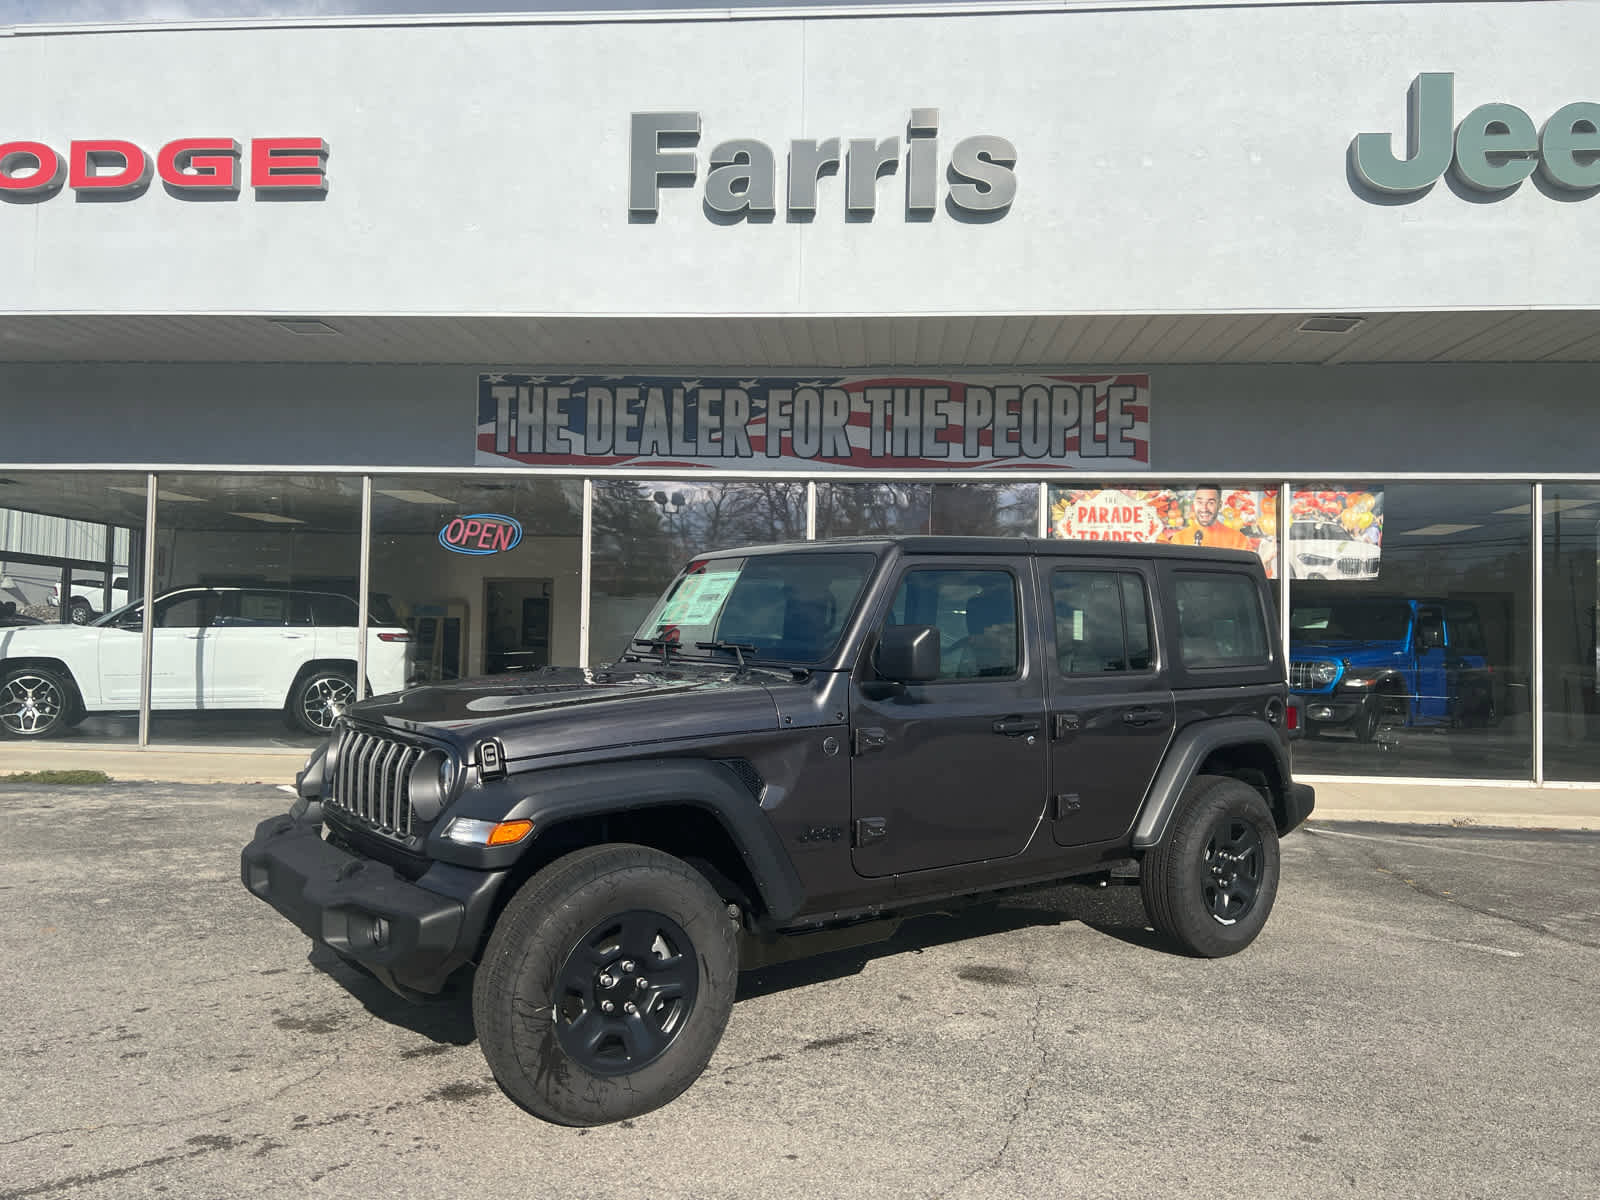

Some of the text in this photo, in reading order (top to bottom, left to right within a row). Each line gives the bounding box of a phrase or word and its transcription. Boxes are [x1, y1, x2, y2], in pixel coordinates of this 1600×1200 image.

[627, 108, 1018, 225] Farris
[491, 384, 1137, 459] THE DEALER FOR THE PEOPLE
[446, 518, 514, 551] OPEN
[1077, 506, 1143, 524] PARADE
